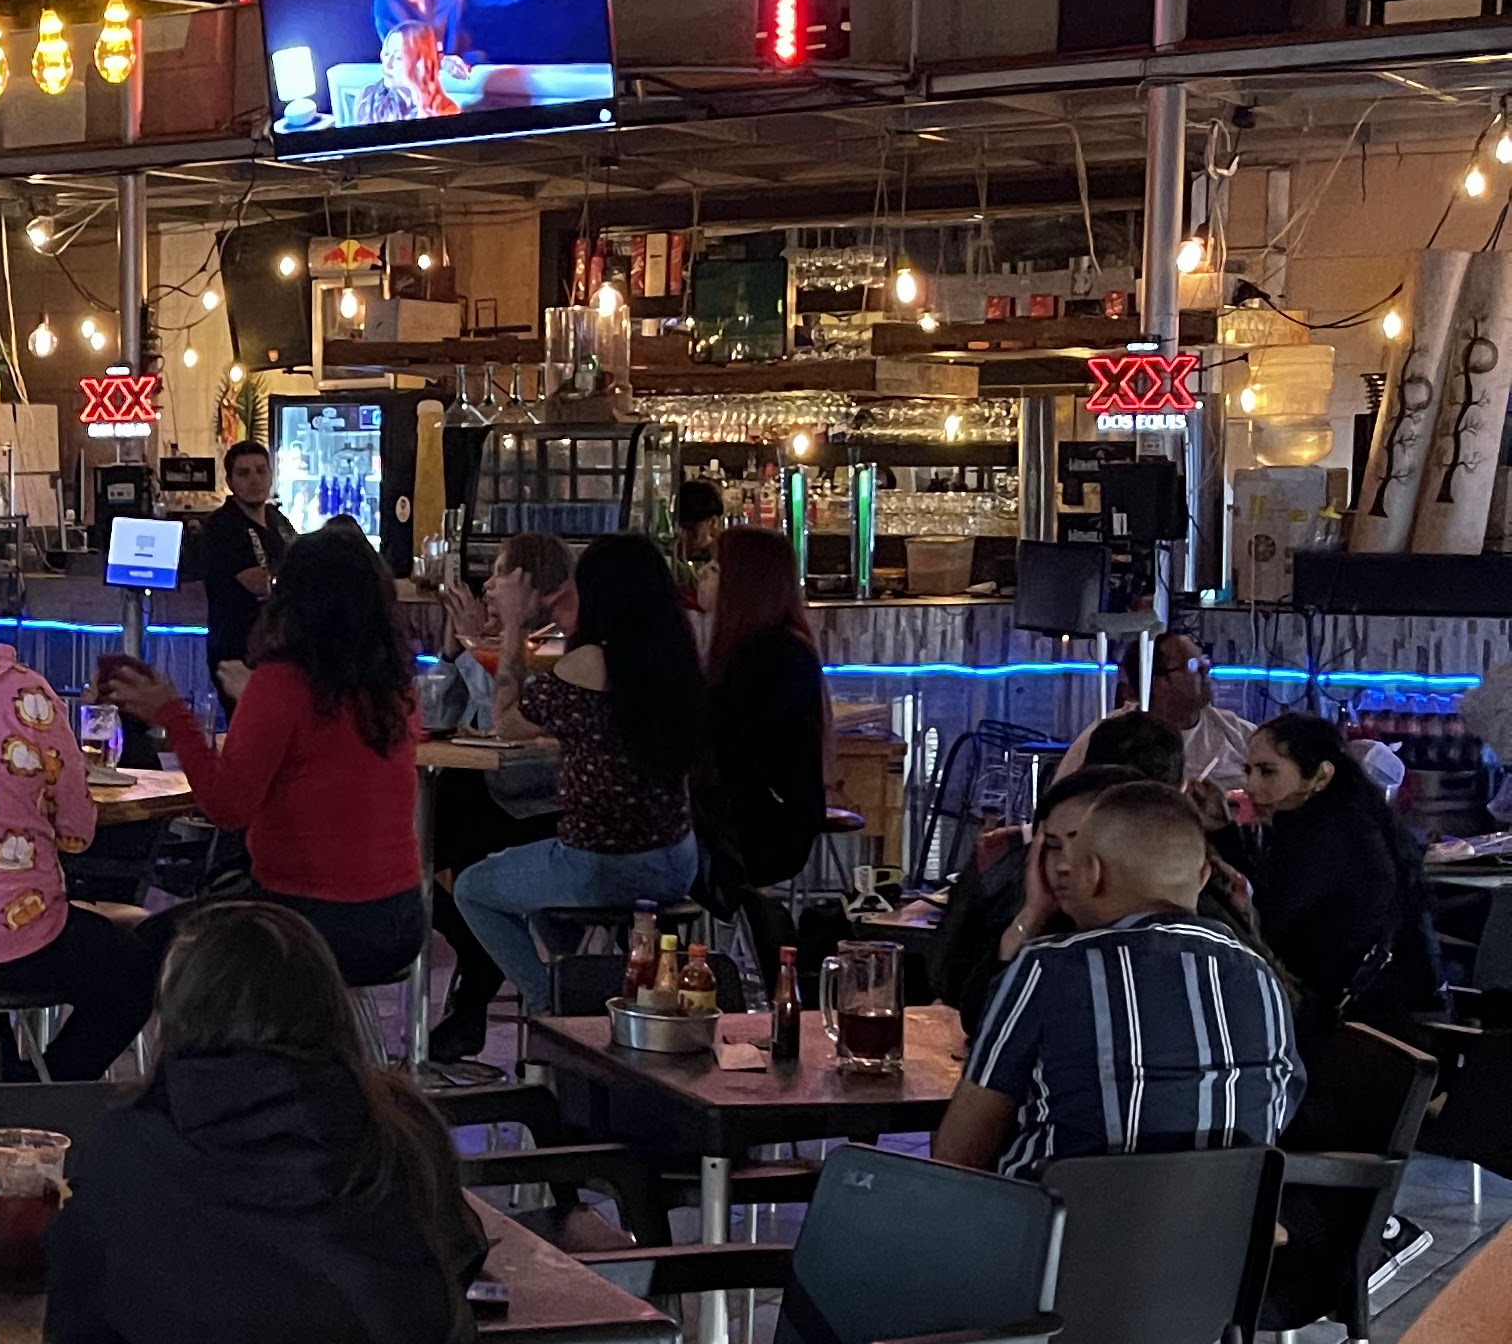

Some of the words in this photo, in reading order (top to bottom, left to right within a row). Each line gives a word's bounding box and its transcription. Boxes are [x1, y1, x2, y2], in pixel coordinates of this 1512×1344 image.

[78, 376, 157, 423] XX
[1086, 356, 1198, 411] XX
[1097, 414, 1134, 431] DOS
